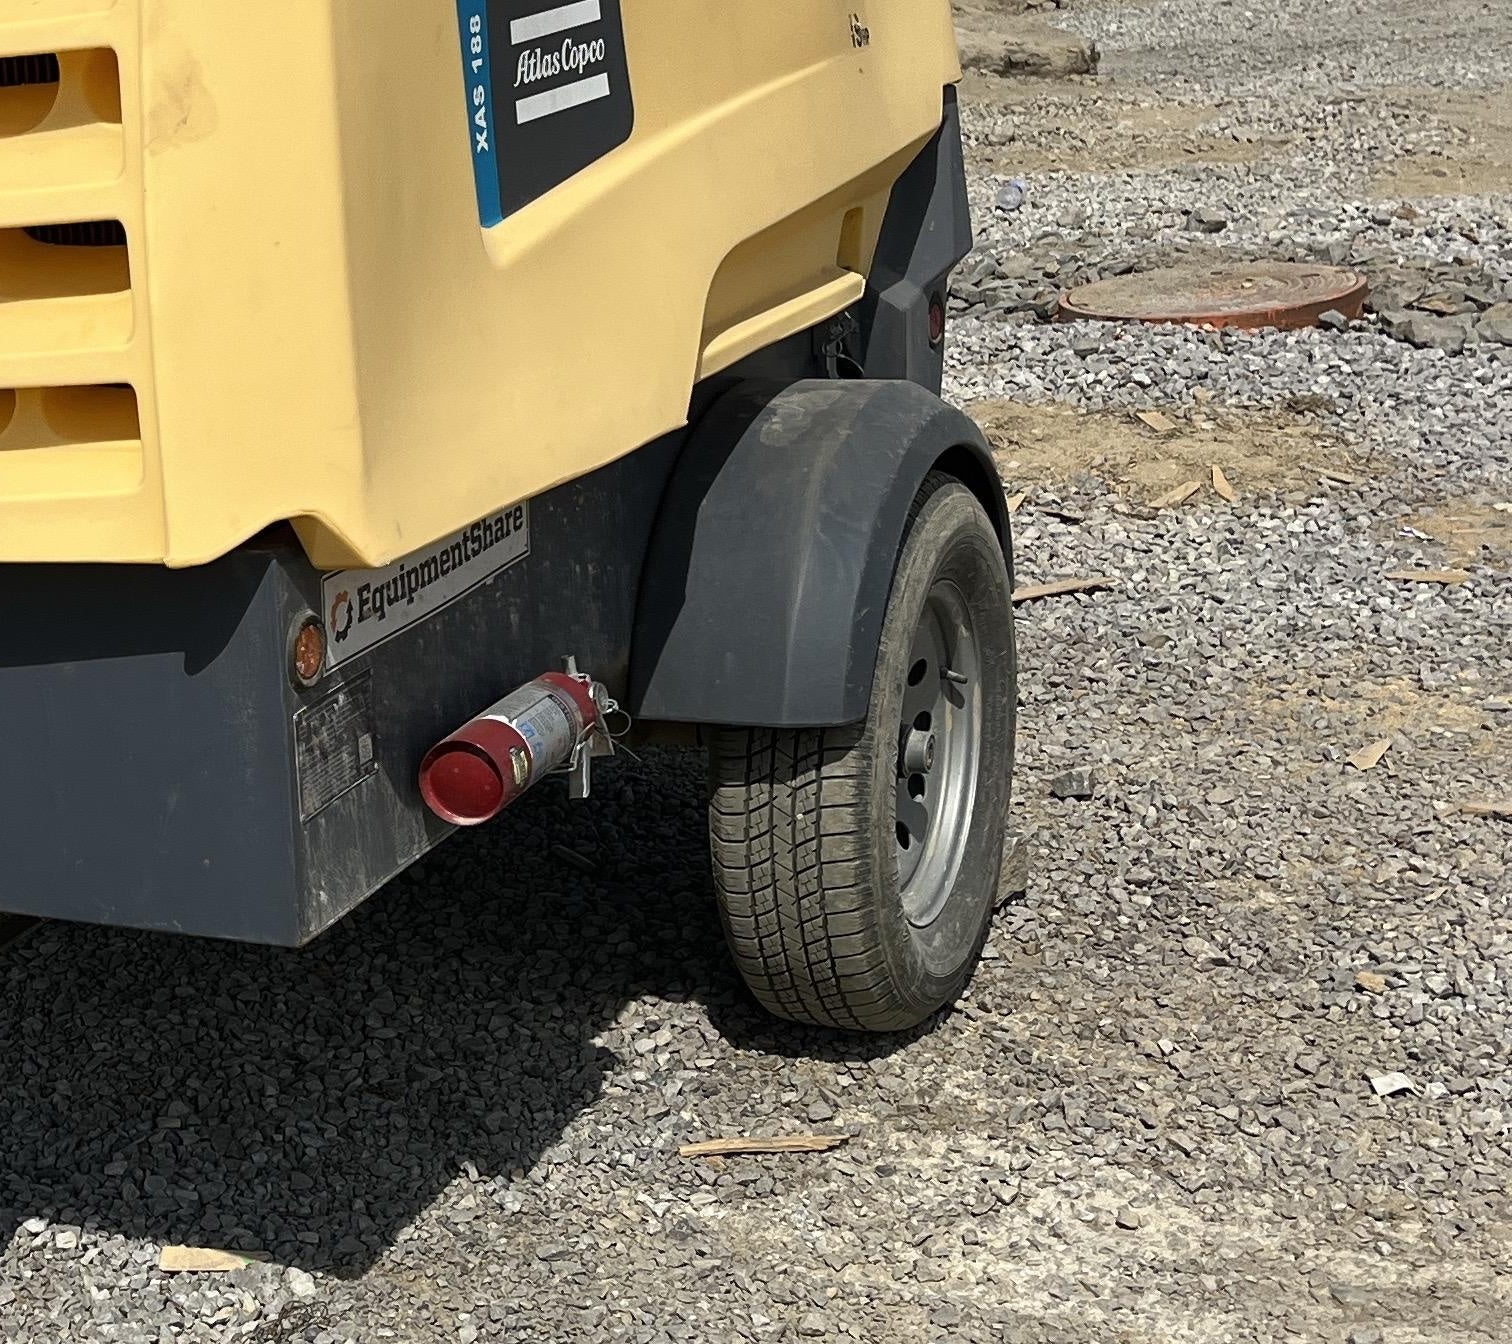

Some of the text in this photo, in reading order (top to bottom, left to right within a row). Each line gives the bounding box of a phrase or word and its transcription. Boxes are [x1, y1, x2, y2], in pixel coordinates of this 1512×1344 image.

[468, 13, 489, 154] XAS 188
[356, 504, 525, 623] EquipmentShare
